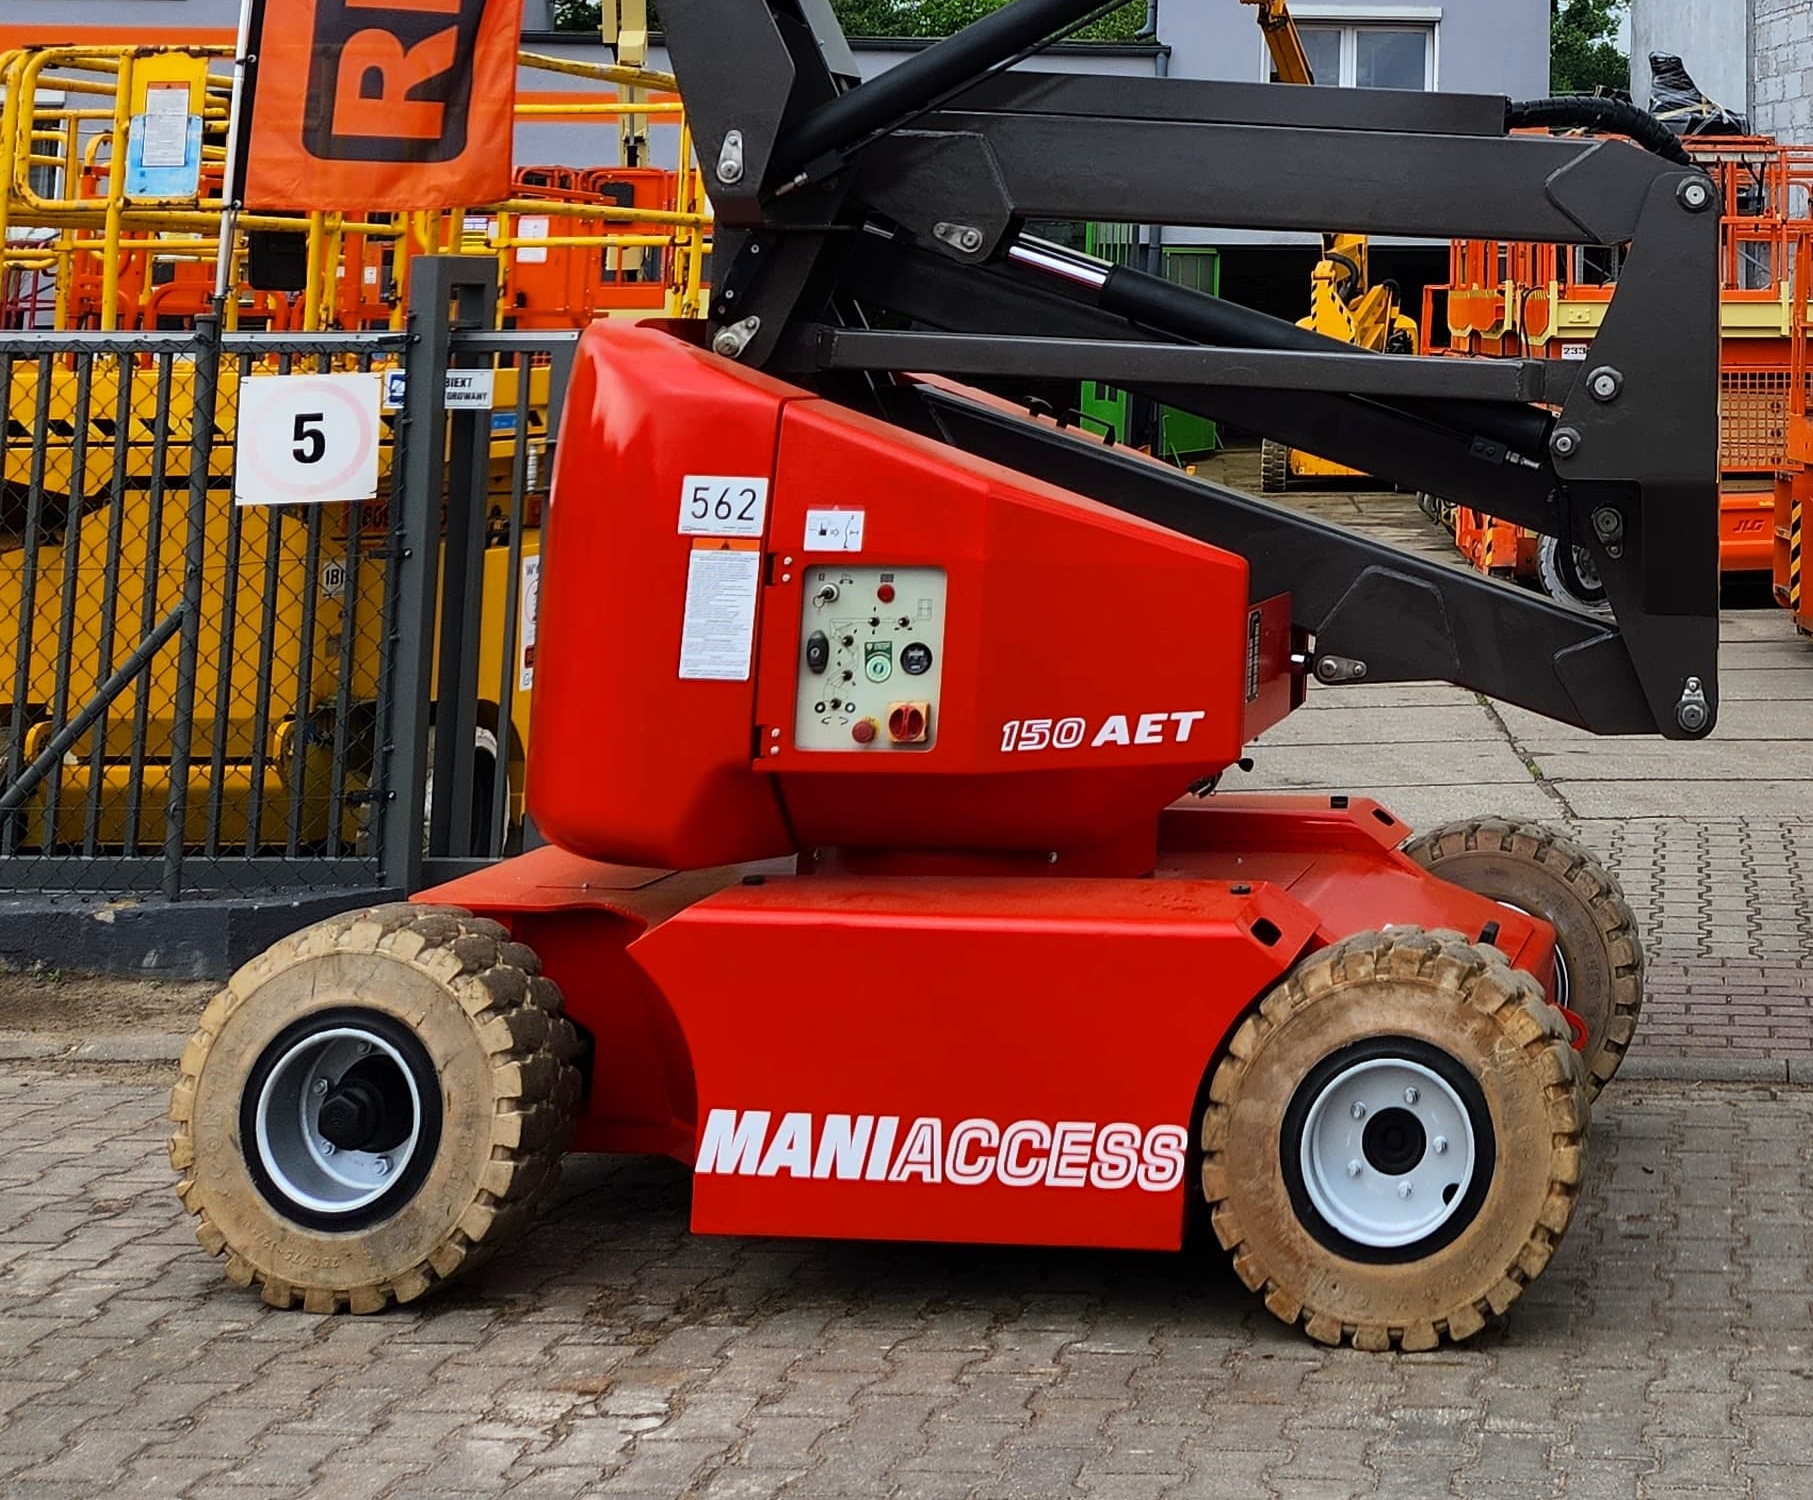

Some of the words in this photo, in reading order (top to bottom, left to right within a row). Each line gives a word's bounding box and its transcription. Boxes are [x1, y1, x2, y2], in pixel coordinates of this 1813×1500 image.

[292, 412, 326, 465] 5
[690, 486, 757, 521] 562
[1000, 717, 1086, 752] 150
[1091, 710, 1205, 747] AET
[694, 1109, 1188, 1192] MANIACCESS
